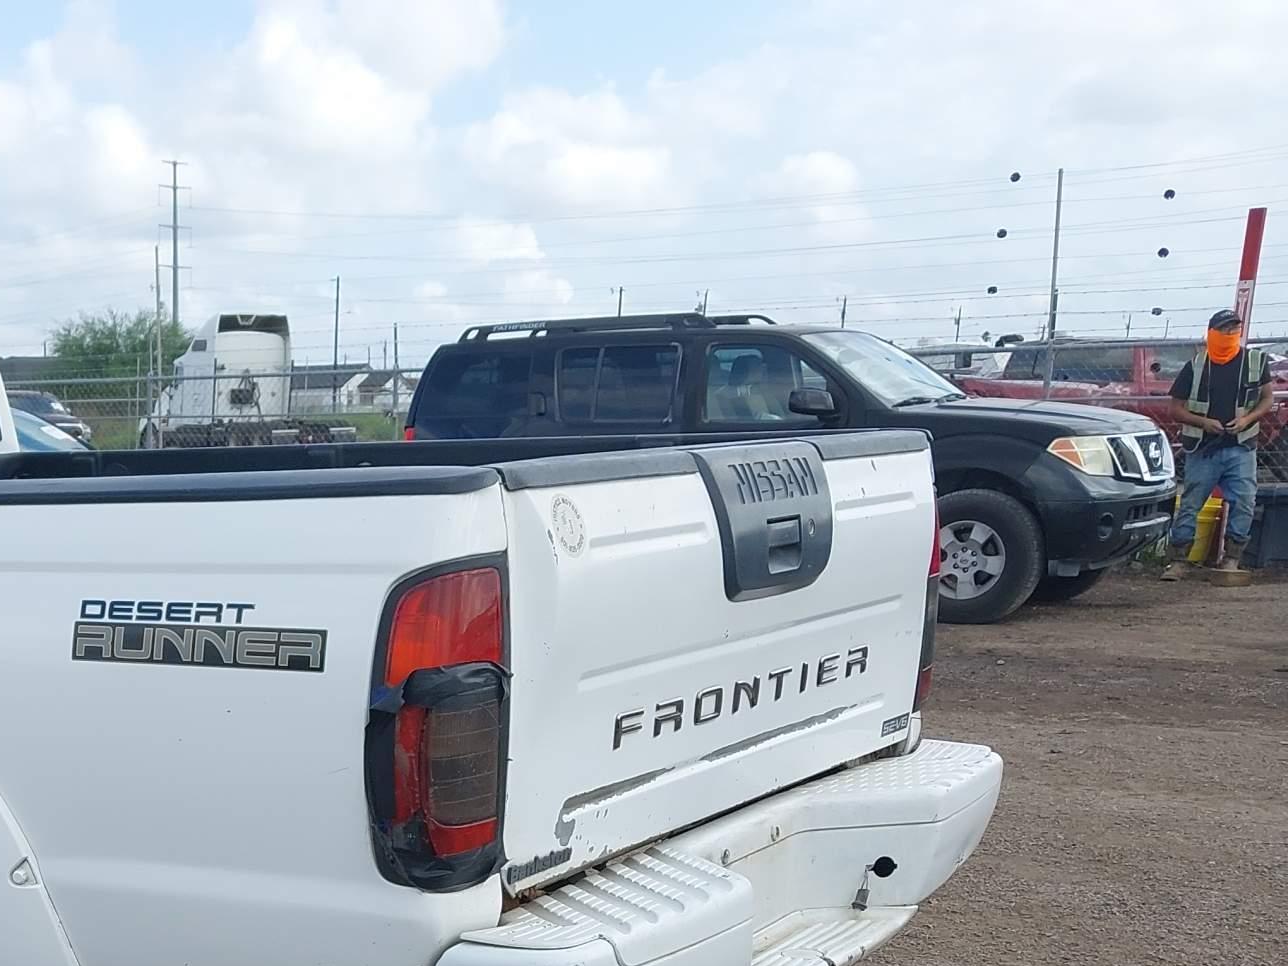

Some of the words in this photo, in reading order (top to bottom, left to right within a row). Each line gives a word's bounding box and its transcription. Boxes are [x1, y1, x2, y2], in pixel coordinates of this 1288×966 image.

[727, 457, 818, 504] NISSAN
[79, 599, 256, 624] DESERT
[75, 624, 323, 669] RUNNER
[612, 645, 869, 750] FRONTIER
